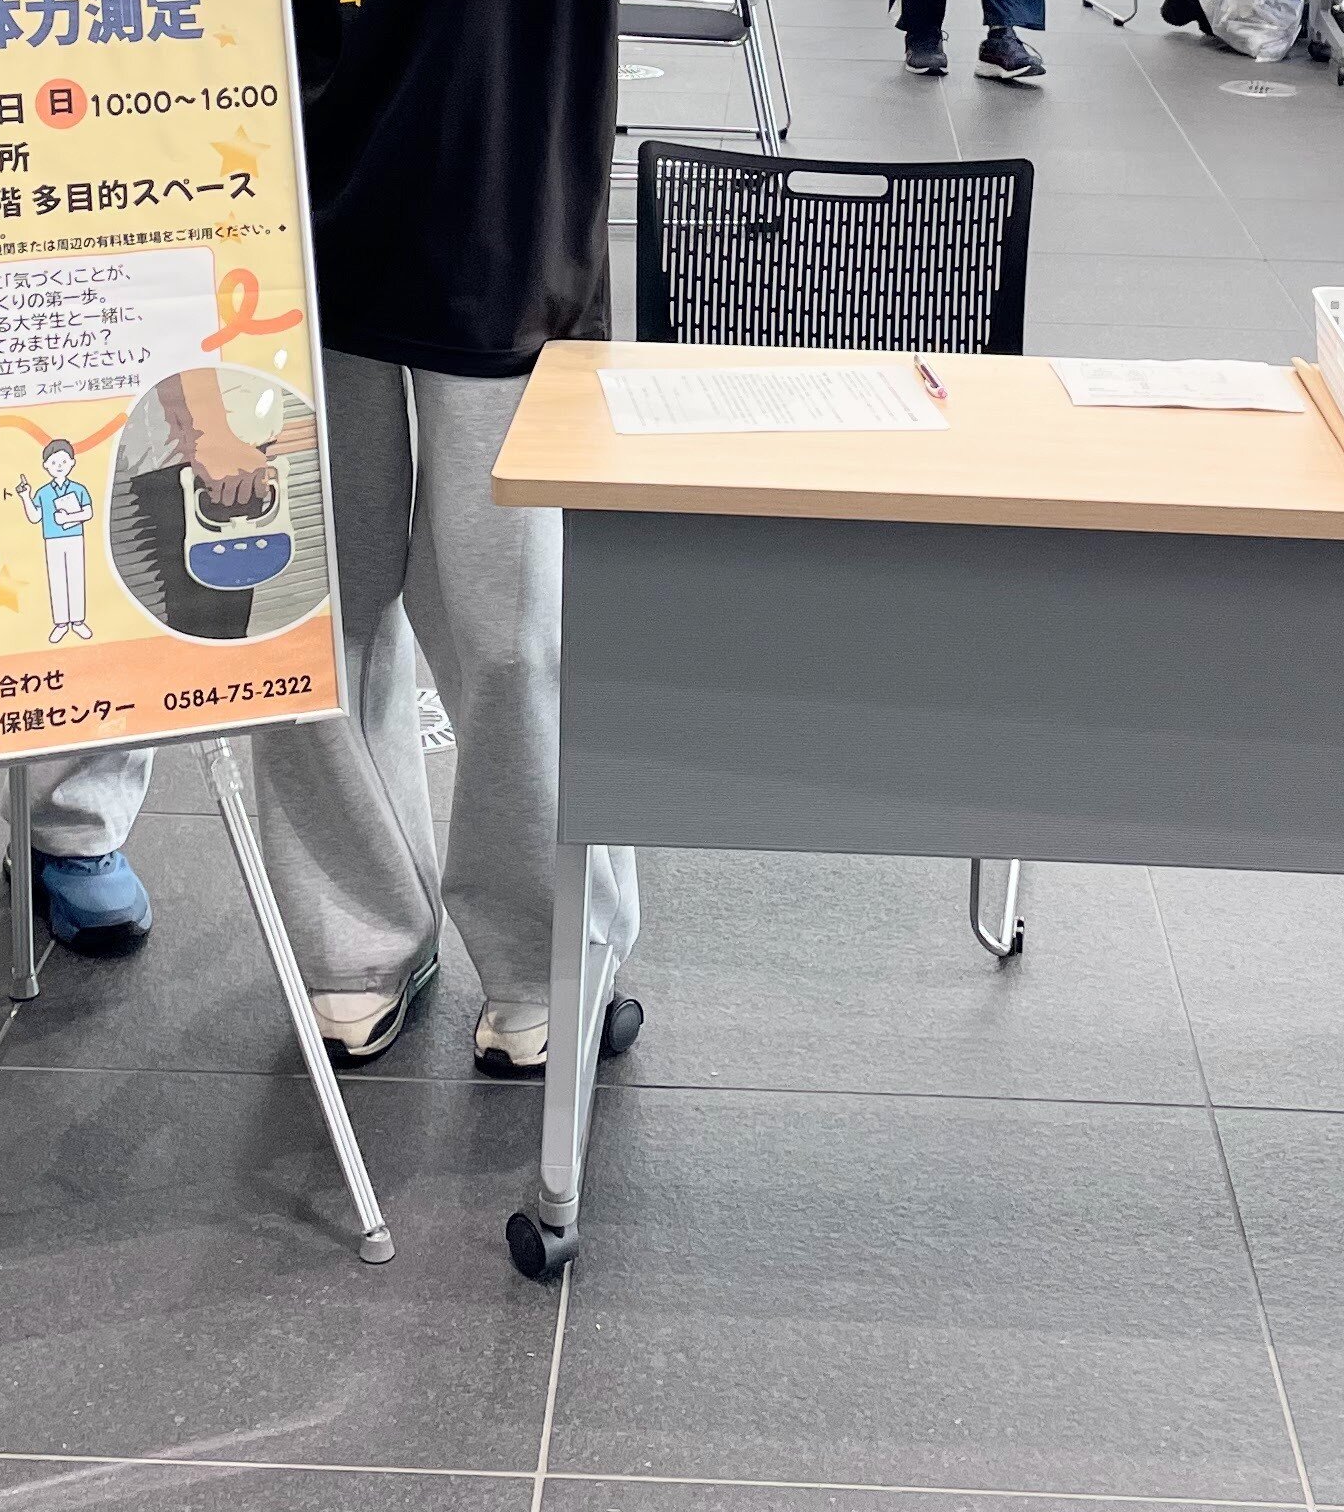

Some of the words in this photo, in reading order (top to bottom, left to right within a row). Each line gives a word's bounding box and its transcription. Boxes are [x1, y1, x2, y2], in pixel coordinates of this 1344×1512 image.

[50, 88, 73, 115] 日
[32, 172, 256, 215] 多目的スペース
[164, 675, 312, 711] 0584-75-2322
